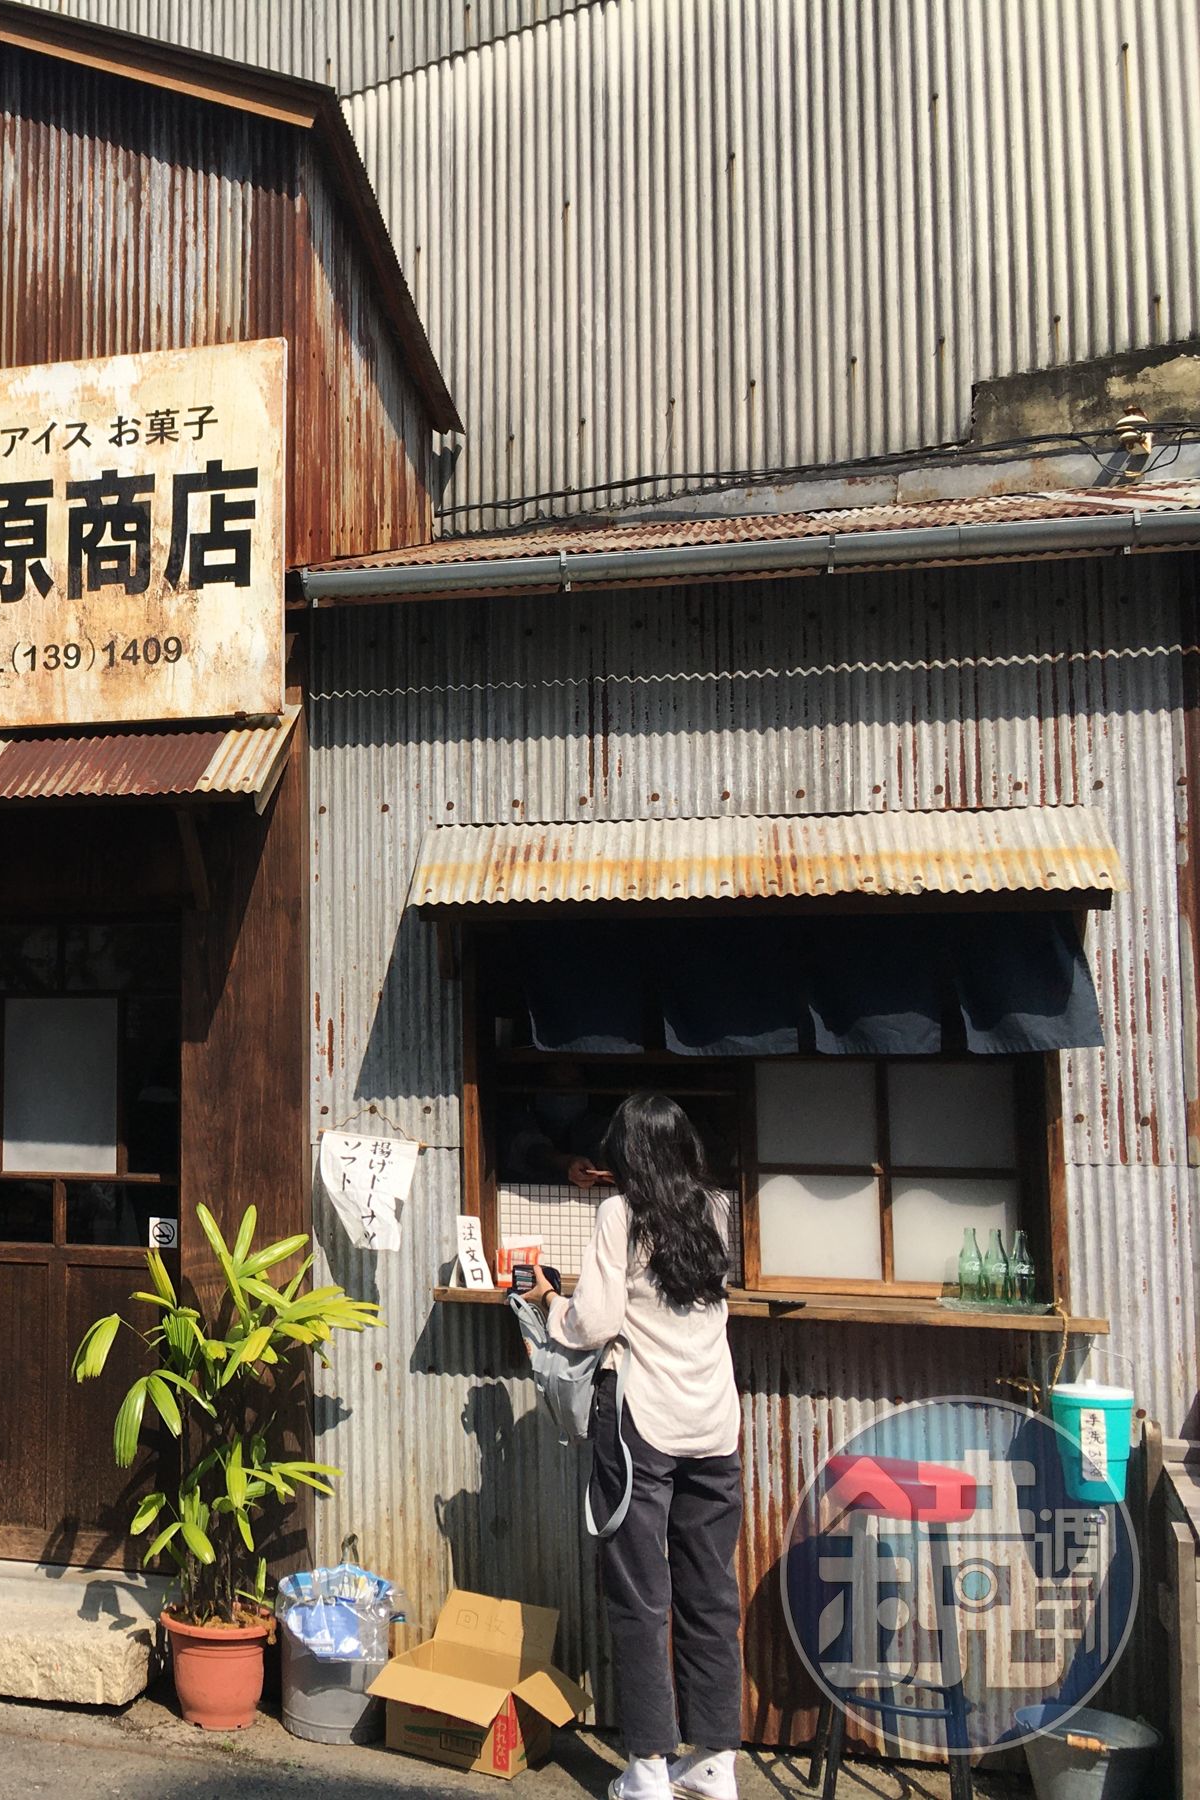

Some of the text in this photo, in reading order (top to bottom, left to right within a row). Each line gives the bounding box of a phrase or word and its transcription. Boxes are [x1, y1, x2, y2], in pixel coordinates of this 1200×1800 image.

[0, 418, 91, 458] アイス
[107, 404, 219, 447] お菓子
[340, 1140, 363, 1192] ソフト
[361, 1140, 394, 1244] 揚げドーナツ
[461, 1222, 484, 1285] 注文口
